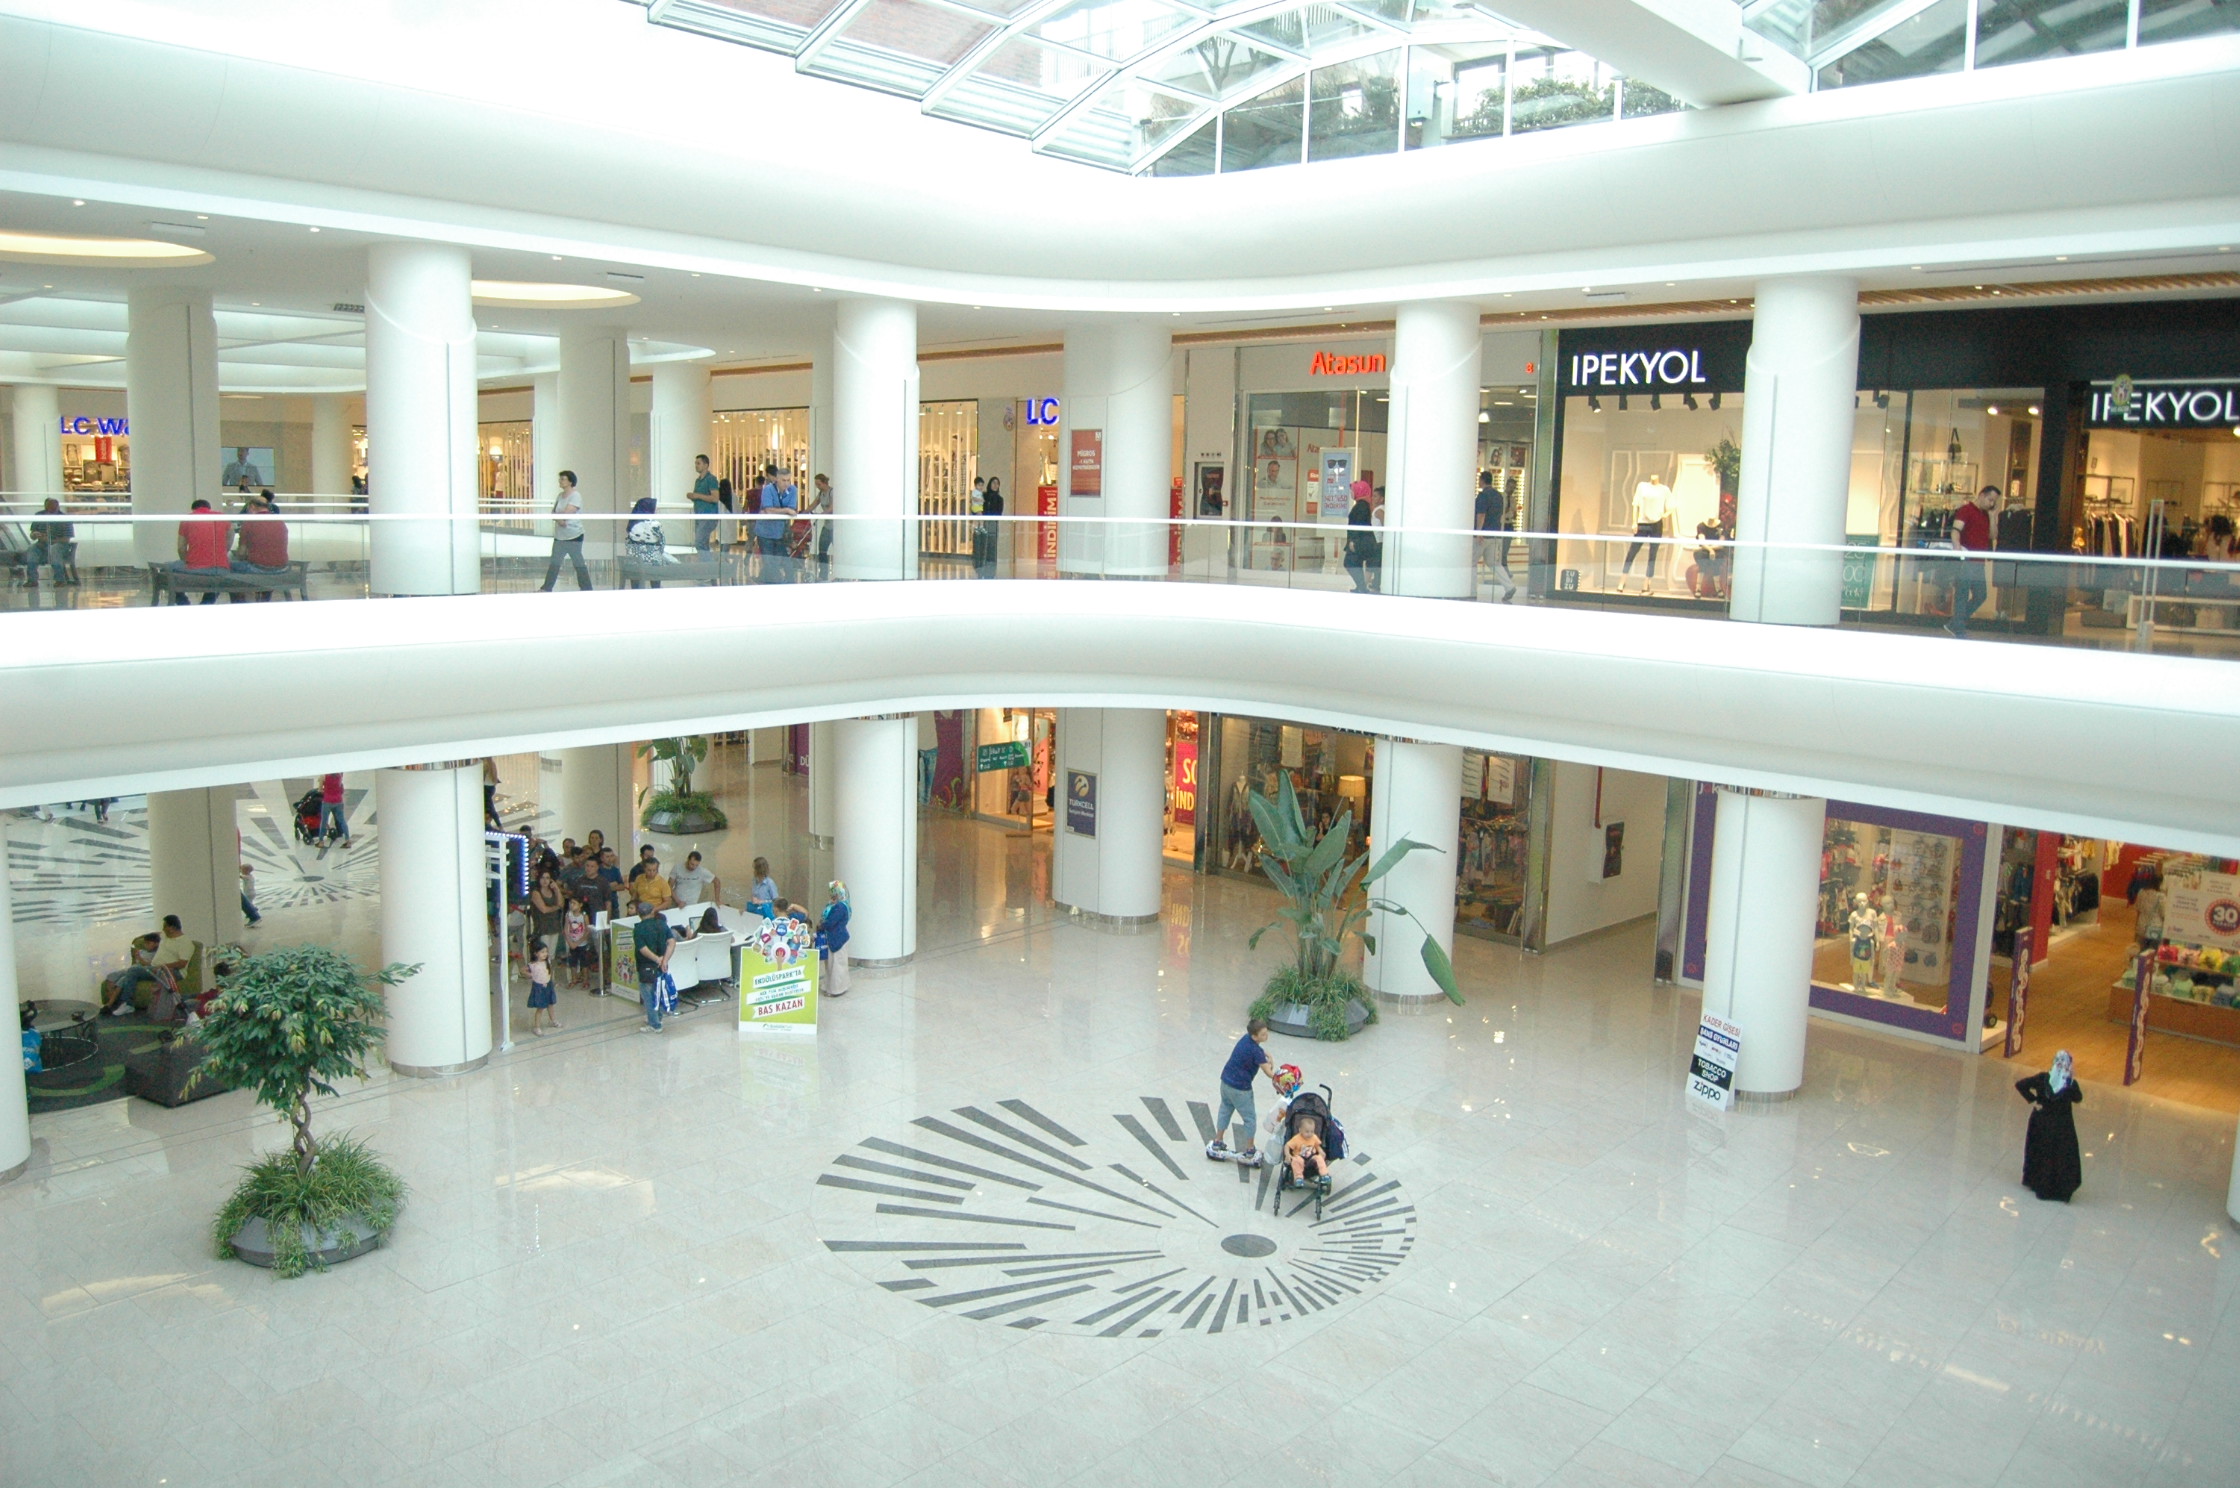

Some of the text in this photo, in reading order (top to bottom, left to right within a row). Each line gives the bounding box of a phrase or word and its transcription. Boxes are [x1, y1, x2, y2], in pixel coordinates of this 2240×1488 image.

[1309, 351, 1387, 376] Atasun
[1571, 350, 1707, 387] IPEKYOL
[1027, 397, 1060, 426] LC
[60, 416, 91, 435] LC
[2212, 905, 2239, 925] 30
[775, 998, 804, 1013] KAZAN
[1698, 1057, 1727, 1079] TOBACCO
[1701, 1069, 1719, 1083] SHOP
[1693, 1080, 1721, 1101] zippo
